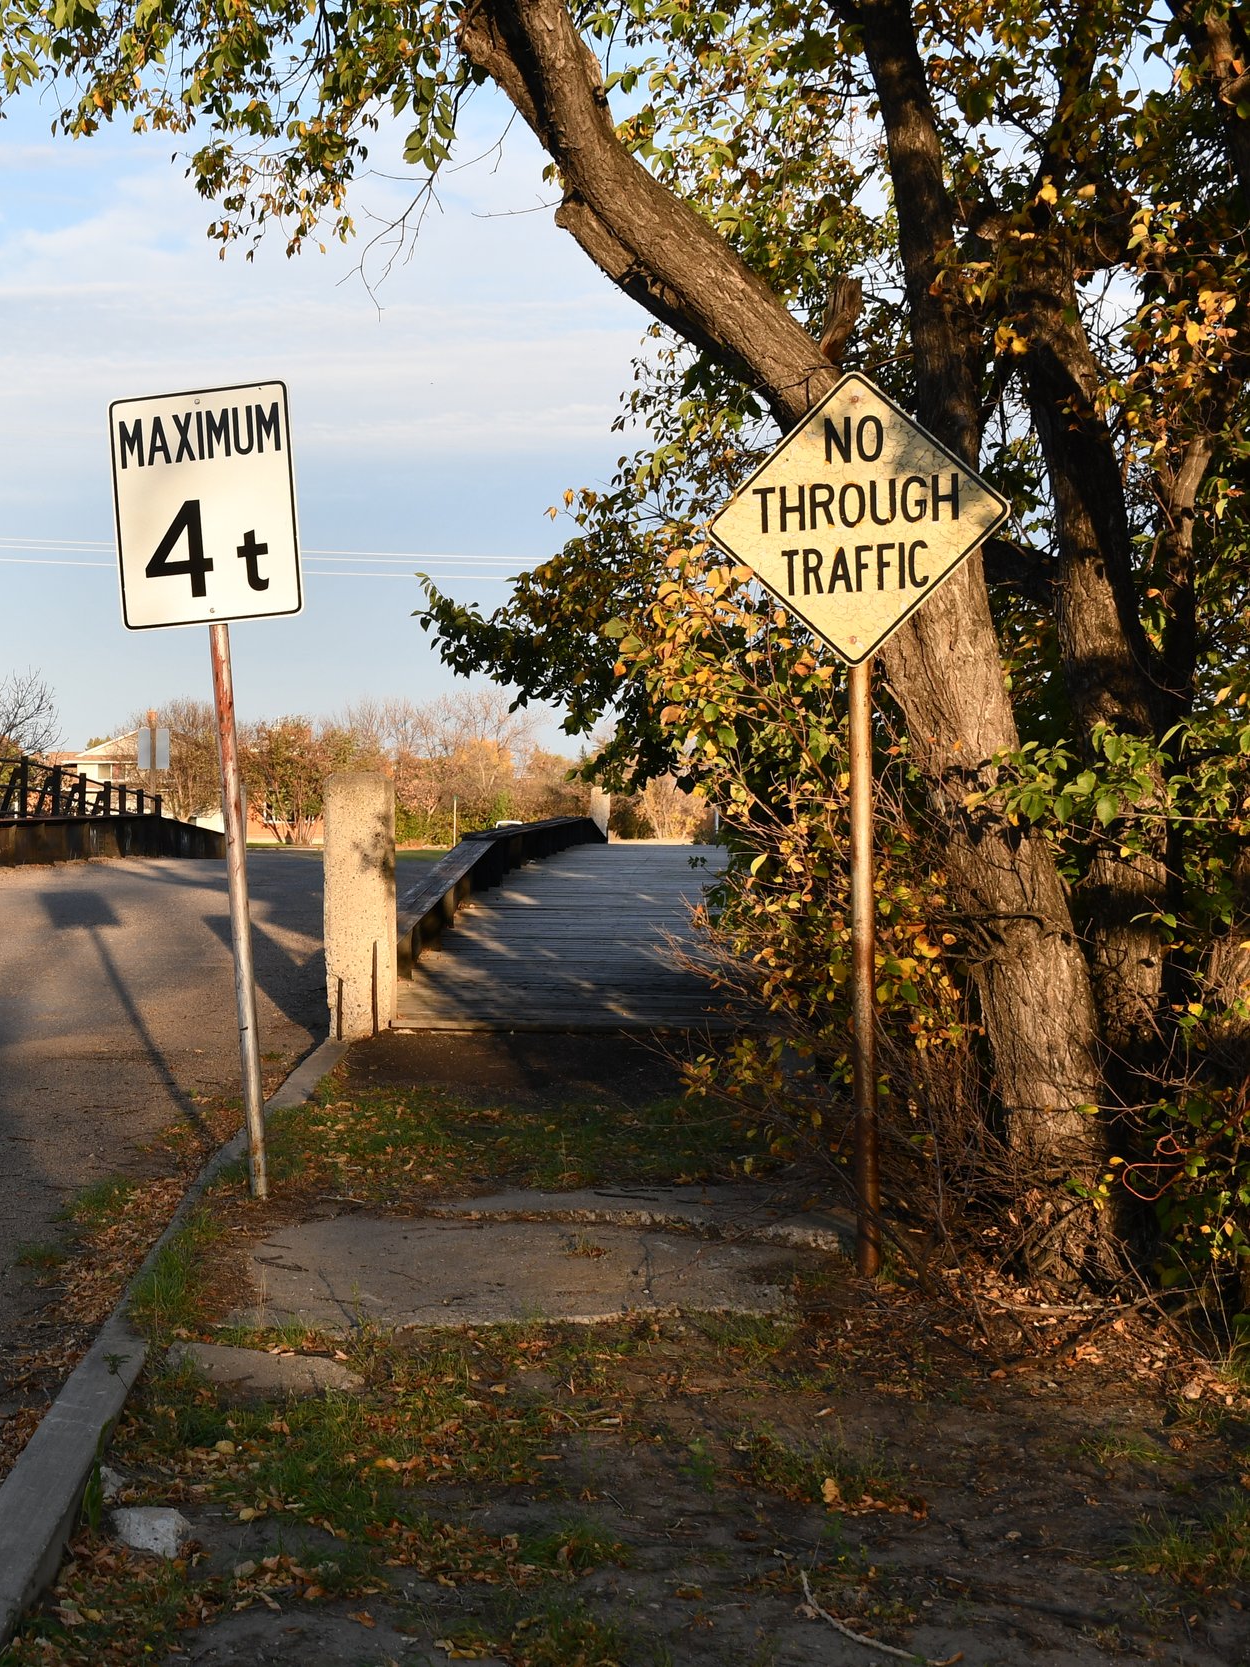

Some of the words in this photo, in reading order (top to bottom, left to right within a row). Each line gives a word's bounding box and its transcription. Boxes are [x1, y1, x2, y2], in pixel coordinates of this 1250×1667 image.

[118, 402, 282, 470] MAXIMUM
[824, 415, 884, 464] NO
[752, 473, 960, 534] THROUGH
[145, 499, 214, 598] 4
[236, 529, 270, 592] t
[781, 540, 929, 596] TRAFFIC
